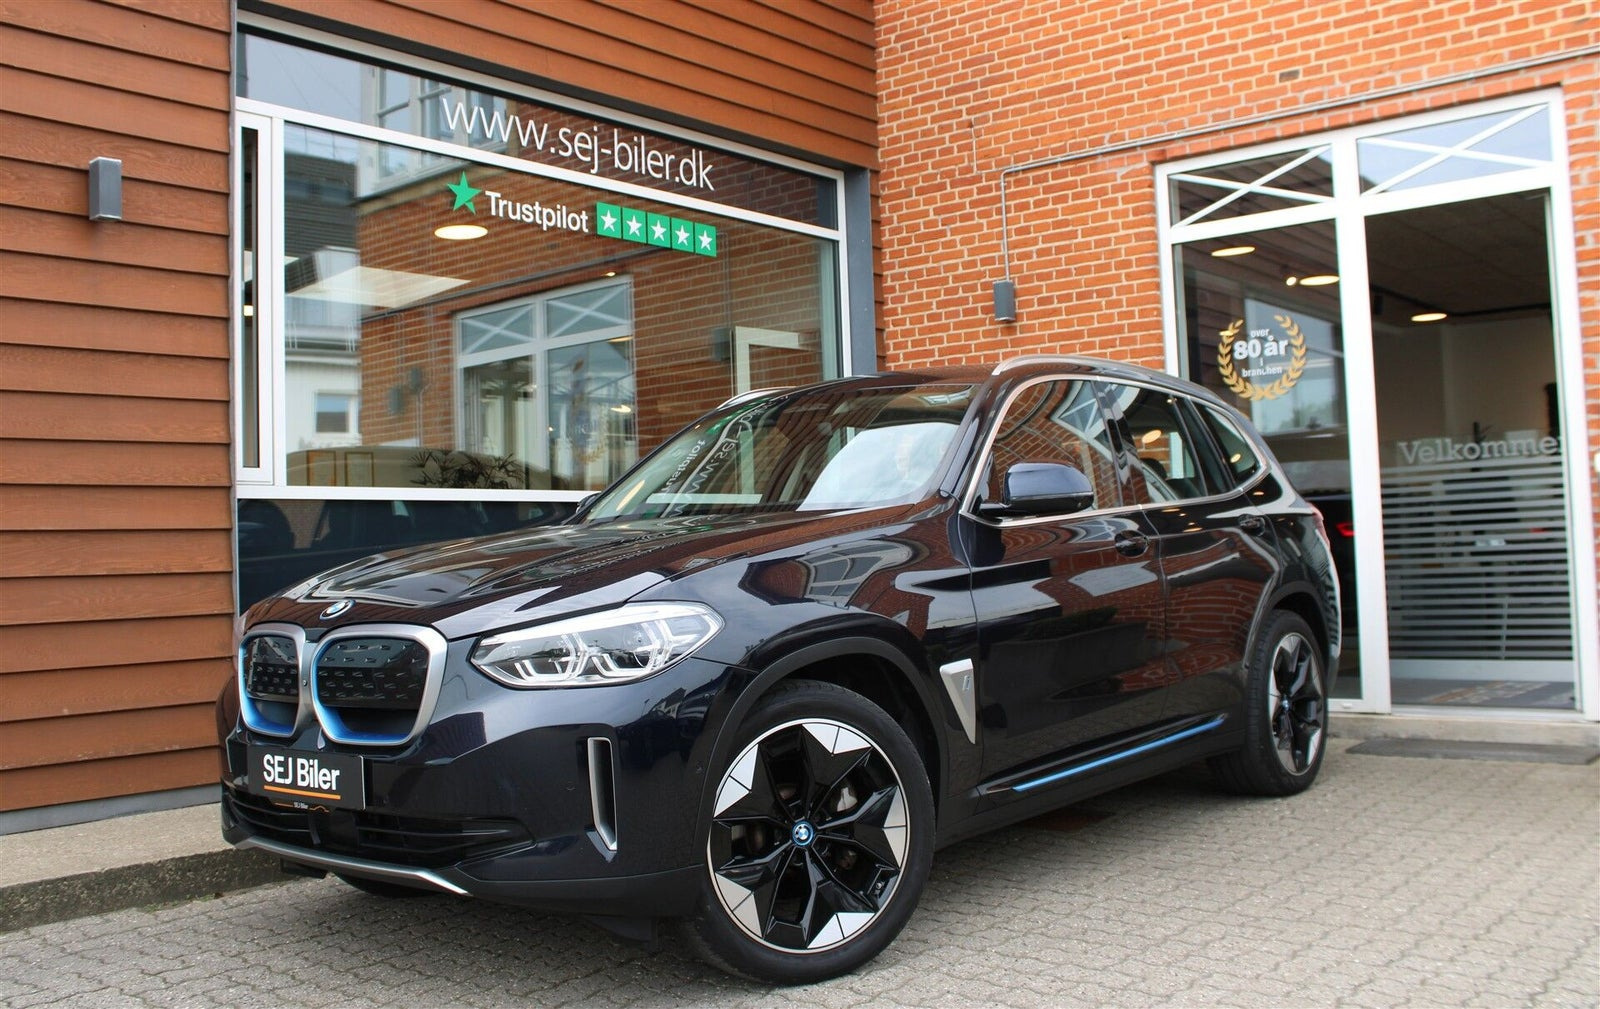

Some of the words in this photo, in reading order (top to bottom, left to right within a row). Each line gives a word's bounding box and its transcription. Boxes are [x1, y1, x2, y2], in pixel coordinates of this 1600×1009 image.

[442, 98, 715, 191] www.sej-biler.dk
[485, 190, 589, 233] Trustpilot
[1233, 339, 1262, 360] 80
[1264, 335, 1289, 357] år
[1250, 328, 1270, 338] over
[1399, 435, 1562, 465] Velkomme
[263, 753, 293, 785] SEJ
[296, 757, 340, 791] Biler
